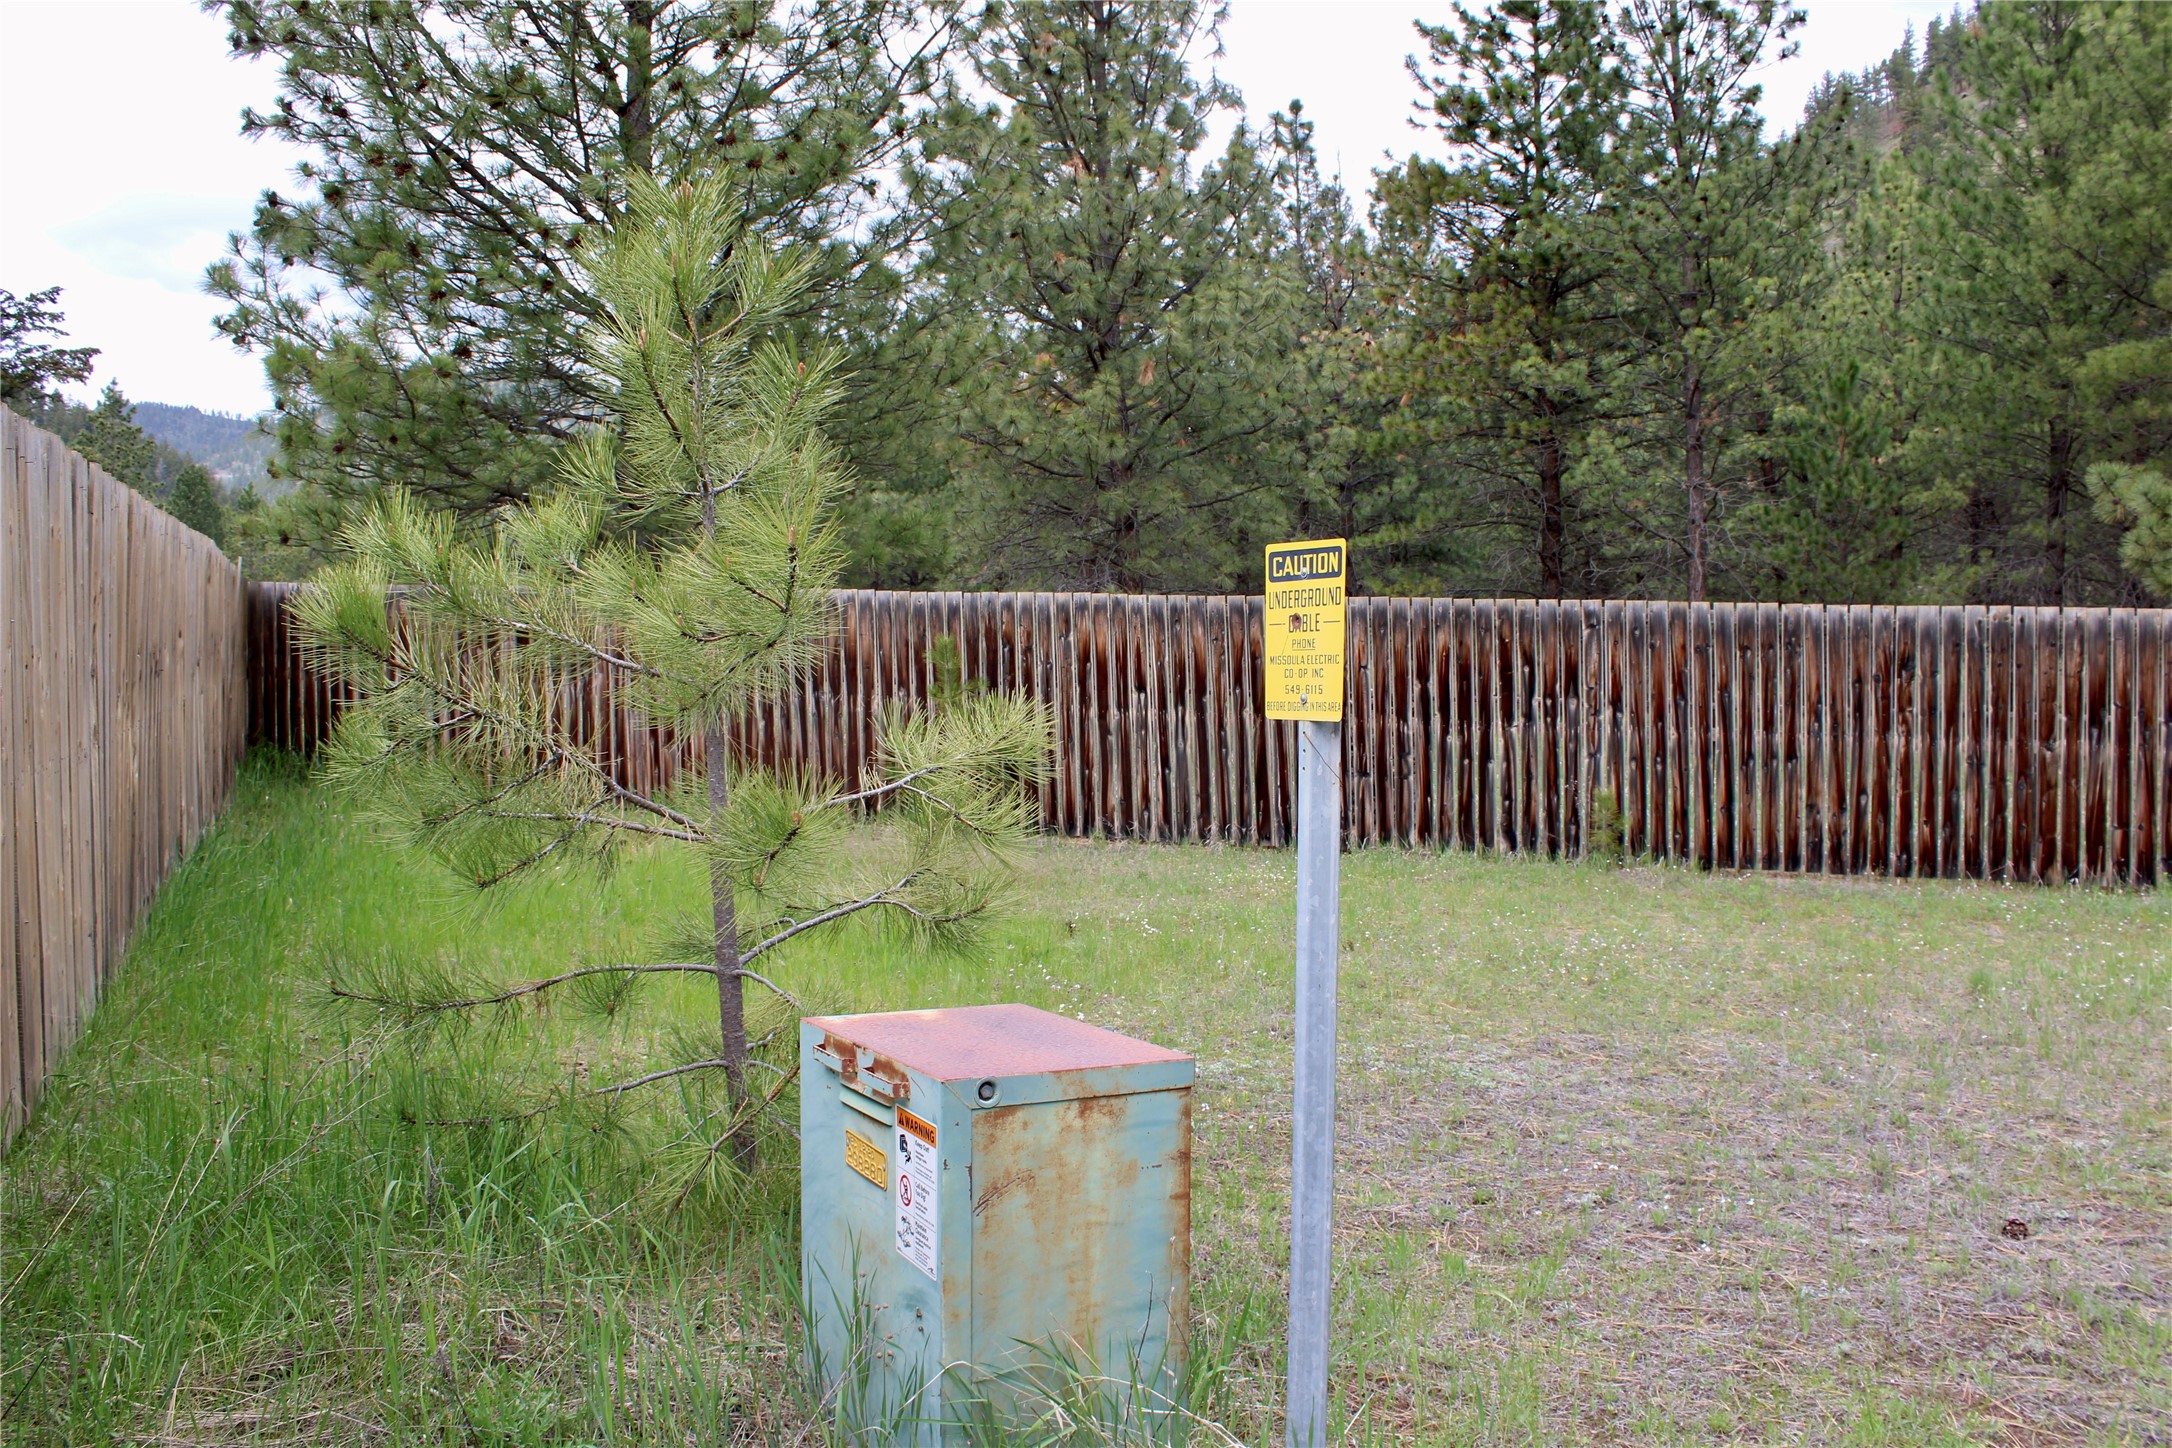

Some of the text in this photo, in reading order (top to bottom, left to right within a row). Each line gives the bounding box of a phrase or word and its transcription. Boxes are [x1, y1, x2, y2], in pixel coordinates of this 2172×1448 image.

[1273, 551, 1338, 577] CAUTION
[1269, 586, 1341, 609] UNDERGROUND
[1289, 613, 1320, 633] CBLE
[1292, 638, 1316, 649] PHONE
[1270, 654, 1340, 665] MISSOULA ELECTRIC
[1311, 668, 1324, 678] INC
[1267, 701, 1286, 712] BEFORE
[1309, 702, 1315, 712] IN
[1315, 702, 1327, 712] THIS
[1328, 702, 1341, 712] AREA
[905, 1114, 935, 1144] WARNING
